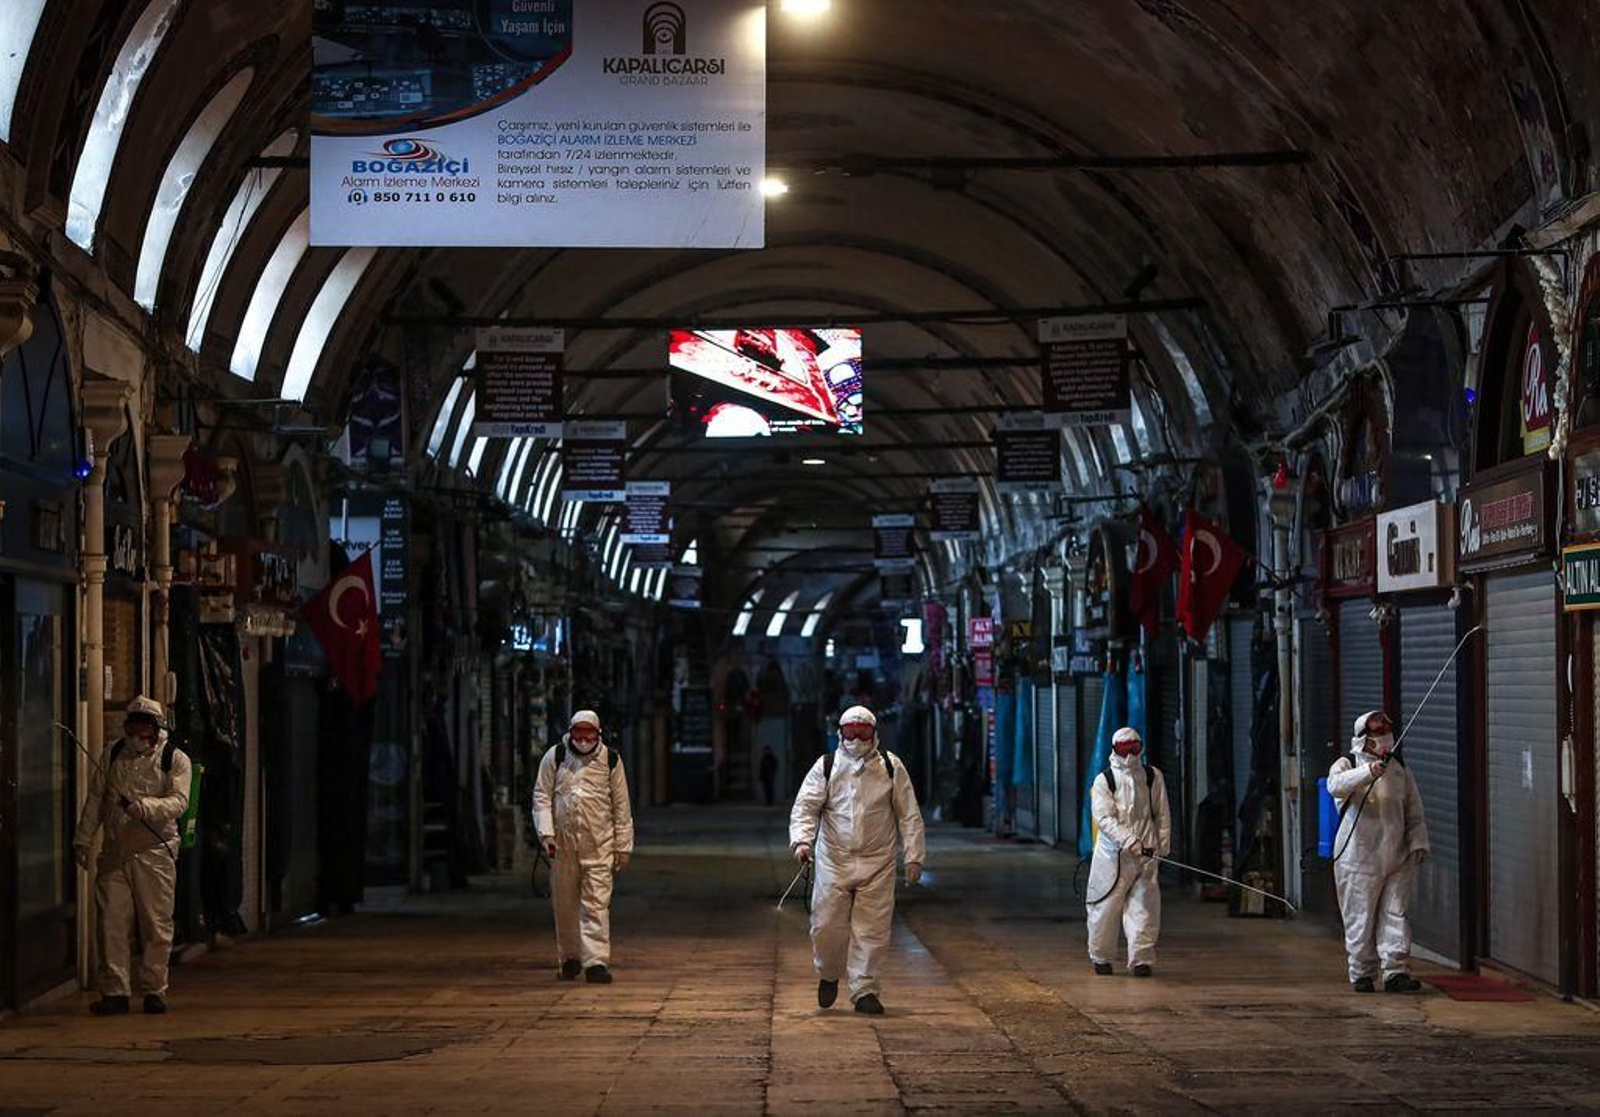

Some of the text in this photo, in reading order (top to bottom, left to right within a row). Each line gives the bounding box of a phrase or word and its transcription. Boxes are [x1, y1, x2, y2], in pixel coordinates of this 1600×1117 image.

[501, 16, 565, 36] Yaşam İçin
[619, 75, 708, 87] GRAND BAZAAR
[555, 120, 581, 133] yeni
[583, 120, 626, 131] kurulan
[628, 121, 678, 133] güvenlik
[680, 121, 735, 132] sistemleri
[738, 121, 752, 132] ile
[560, 134, 601, 146] ALARM
[497, 149, 561, 160] tarafından
[565, 149, 591, 160] 7/24
[352, 157, 470, 176] BOĞAZİÇİ
[497, 163, 542, 176] Bireysel
[578, 163, 584, 175] /
[634, 164, 672, 176] alarm
[676, 164, 732, 176] sistemleri
[735, 166, 751, 176] ve
[341, 175, 380, 188] Alarm
[431, 175, 481, 188] Merkezi
[497, 178, 751, 192] kamera sistemleri talepleriniz için lütfen
[374, 191, 401, 203] 850
[405, 191, 432, 203] 711
[436, 191, 446, 203] 0
[449, 191, 477, 203] 610
[497, 192, 522, 206] bilgi
